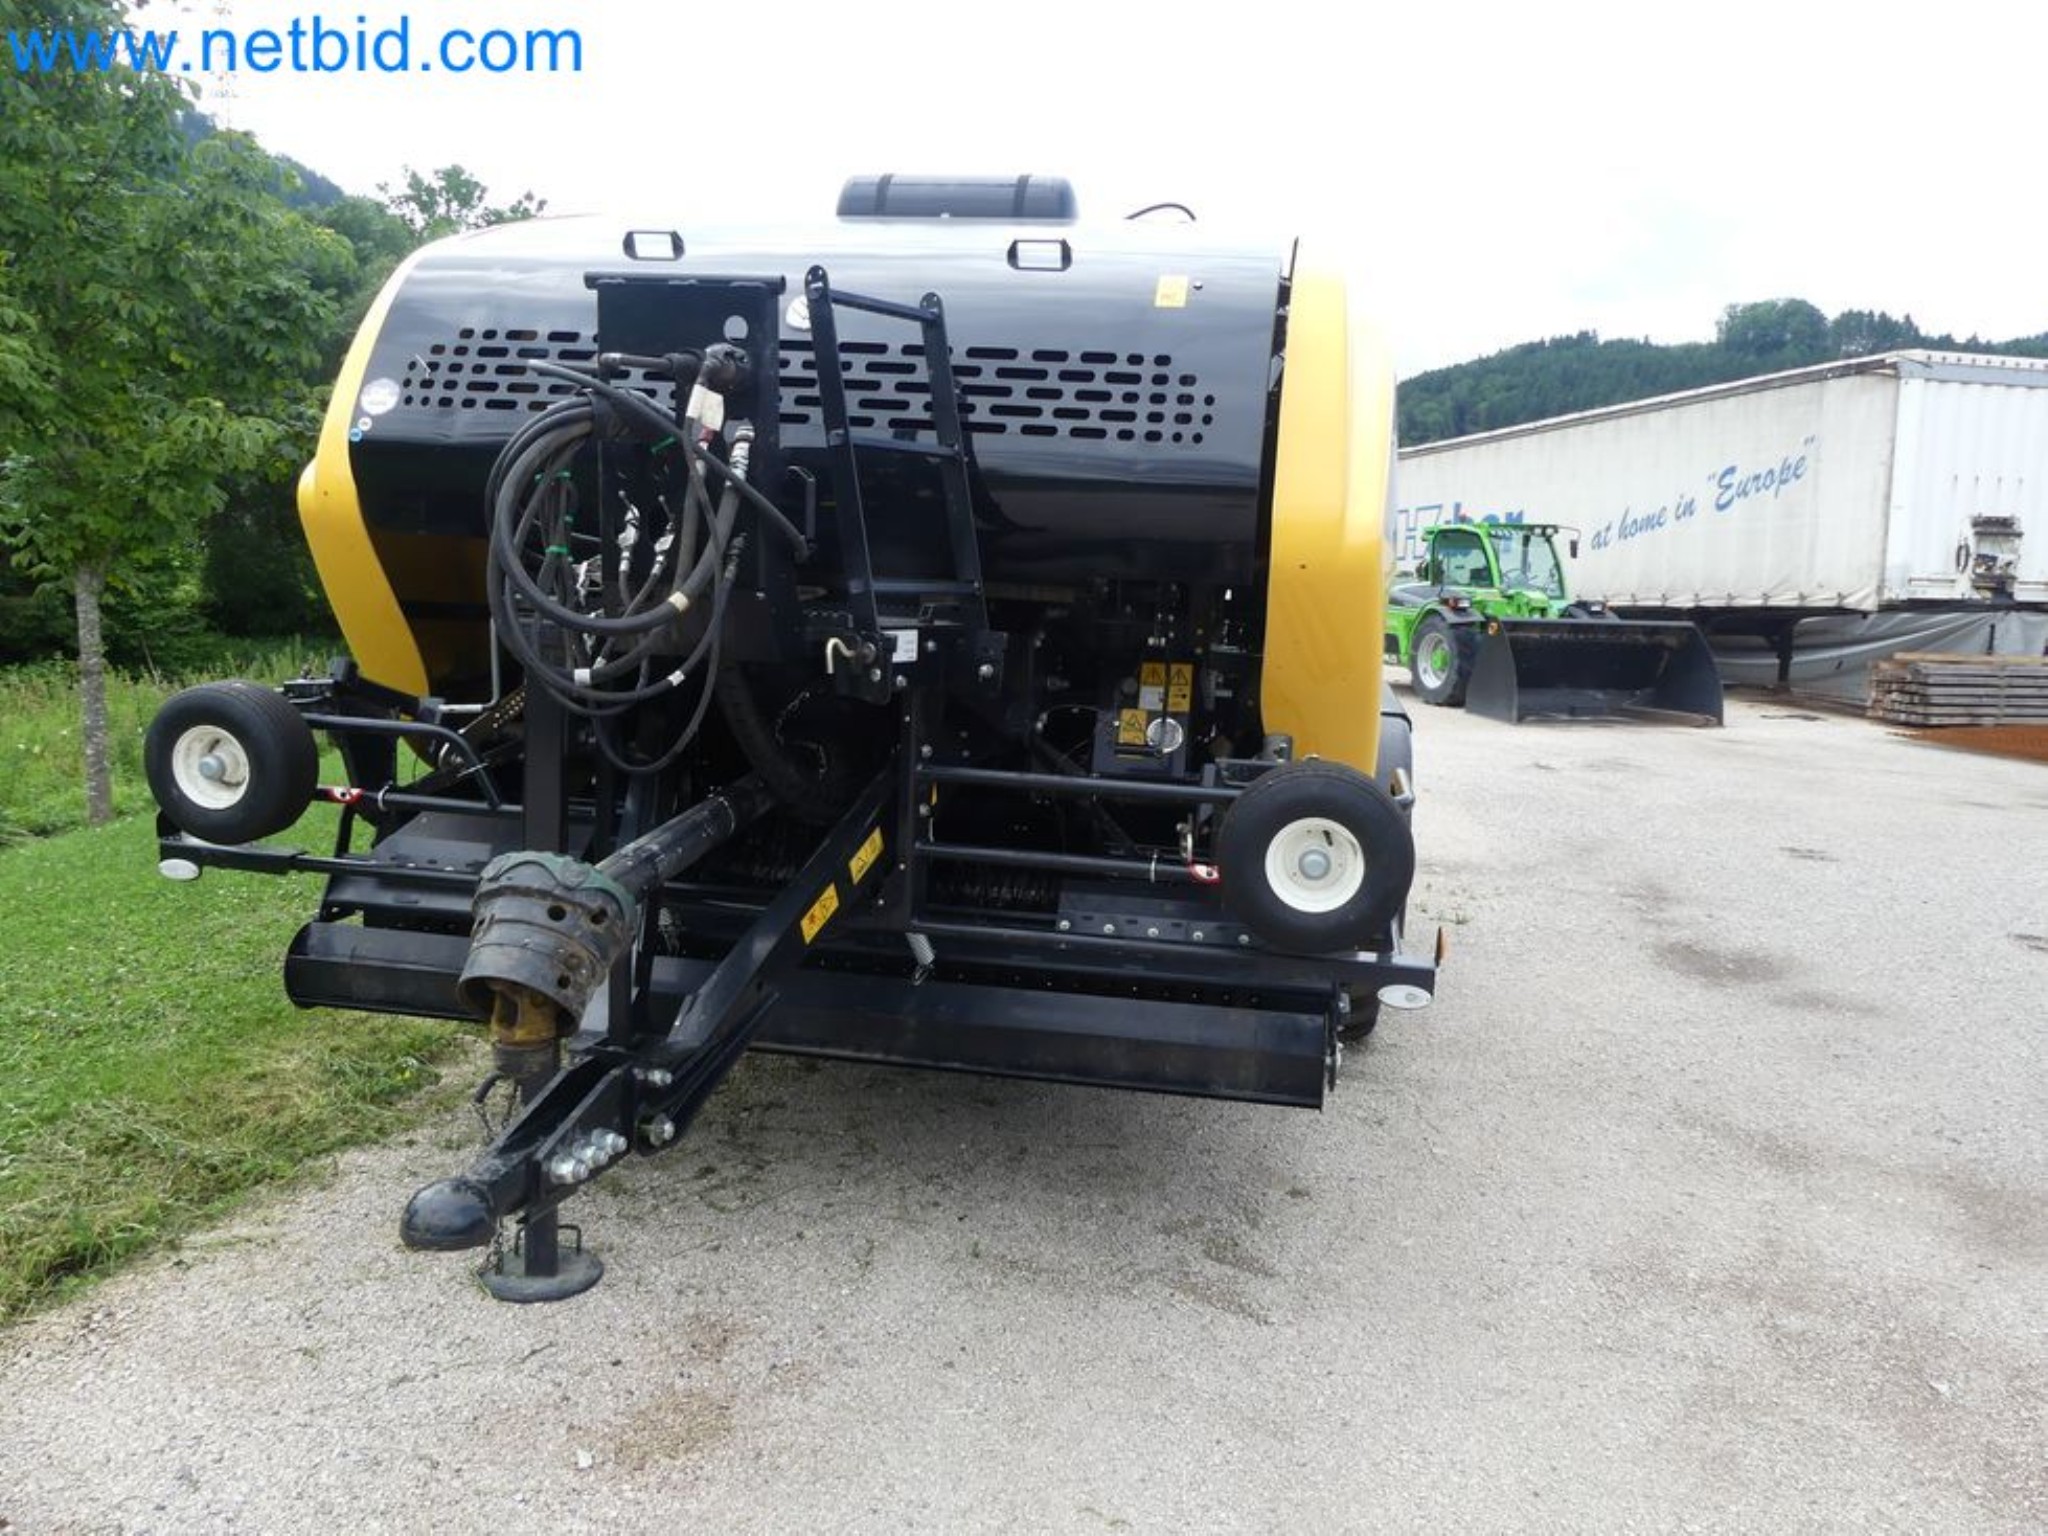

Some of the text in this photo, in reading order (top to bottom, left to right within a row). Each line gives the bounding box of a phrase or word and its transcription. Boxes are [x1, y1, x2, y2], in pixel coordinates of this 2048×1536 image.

[1591, 521, 1611, 550] at
[1618, 506, 1667, 540] home
[1675, 494, 1696, 521] in
